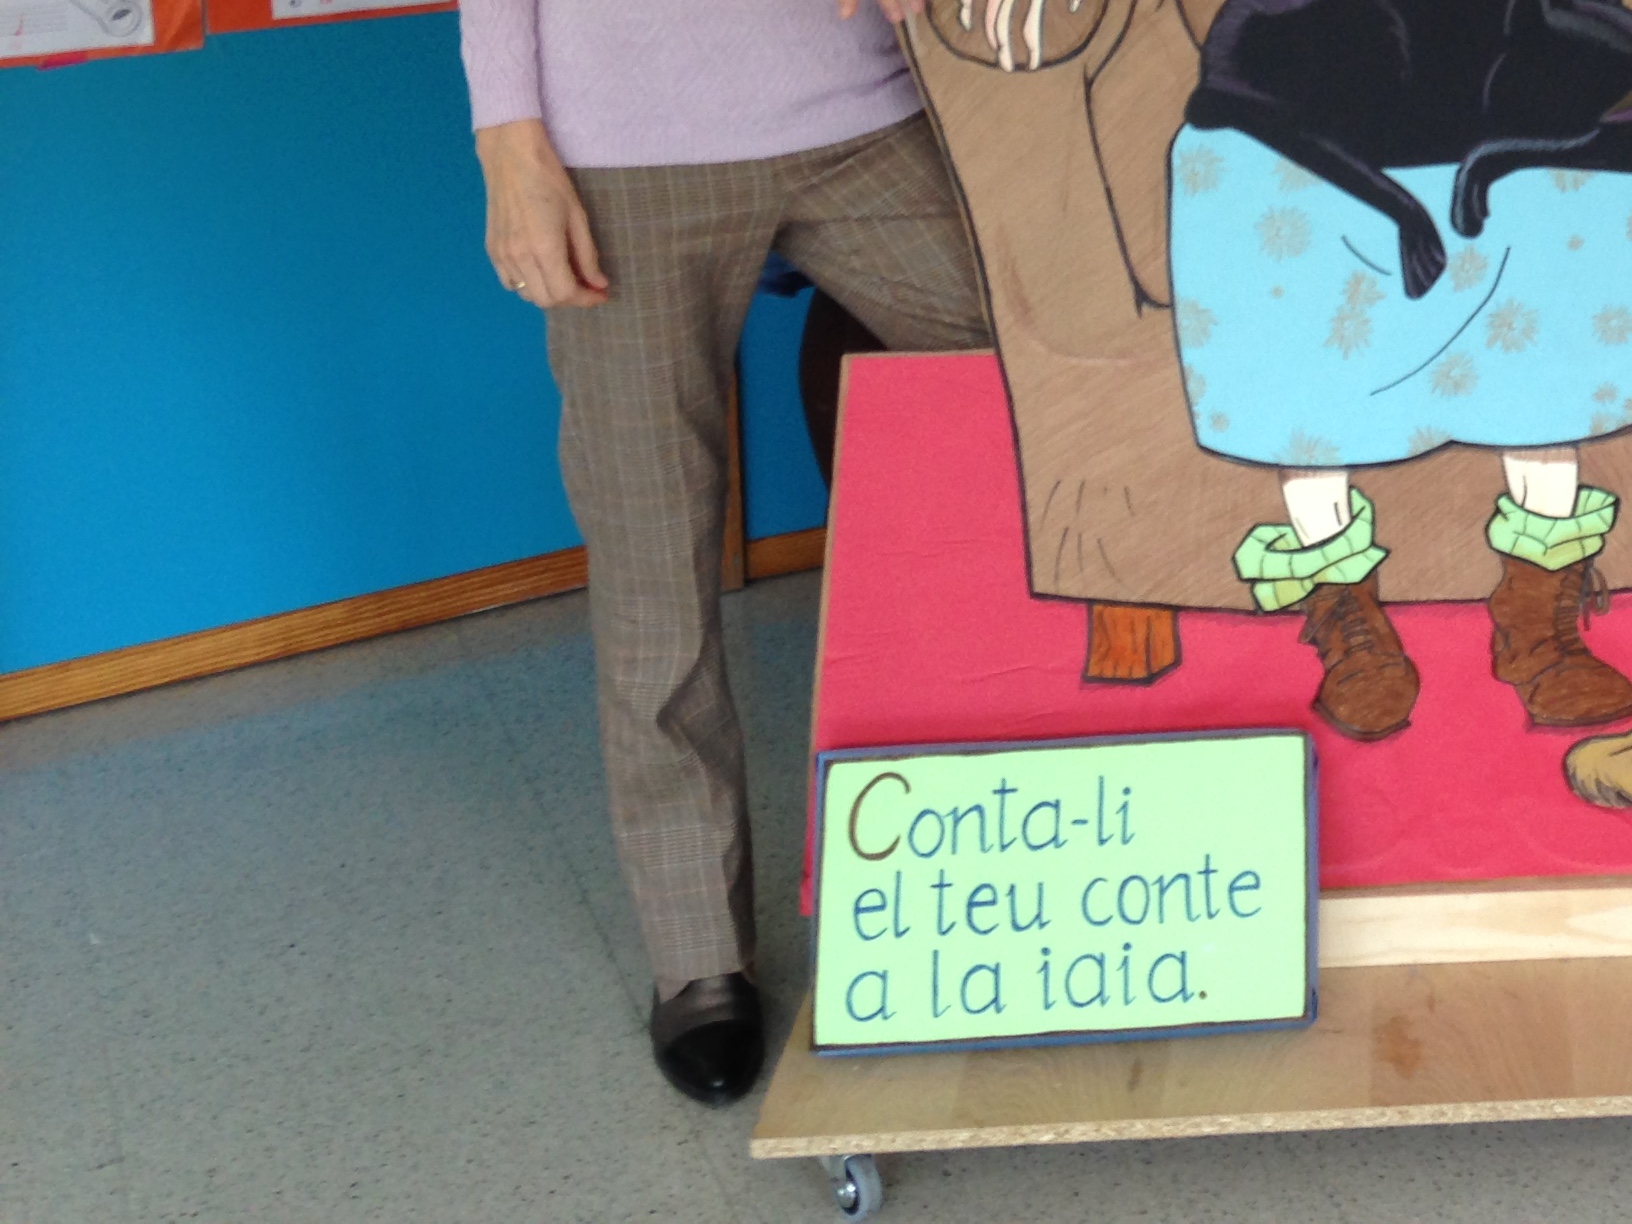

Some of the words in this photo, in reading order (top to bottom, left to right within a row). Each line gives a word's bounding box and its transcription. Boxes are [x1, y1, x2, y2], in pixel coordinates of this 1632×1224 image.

[848, 772, 1136, 861] Conta-li
[853, 869, 910, 941] el
[931, 869, 1051, 936] teu
[1081, 854, 1262, 927] conte
[845, 968, 896, 1022] a
[931, 949, 1006, 1019] la
[1037, 942, 1208, 1011] iaia.
